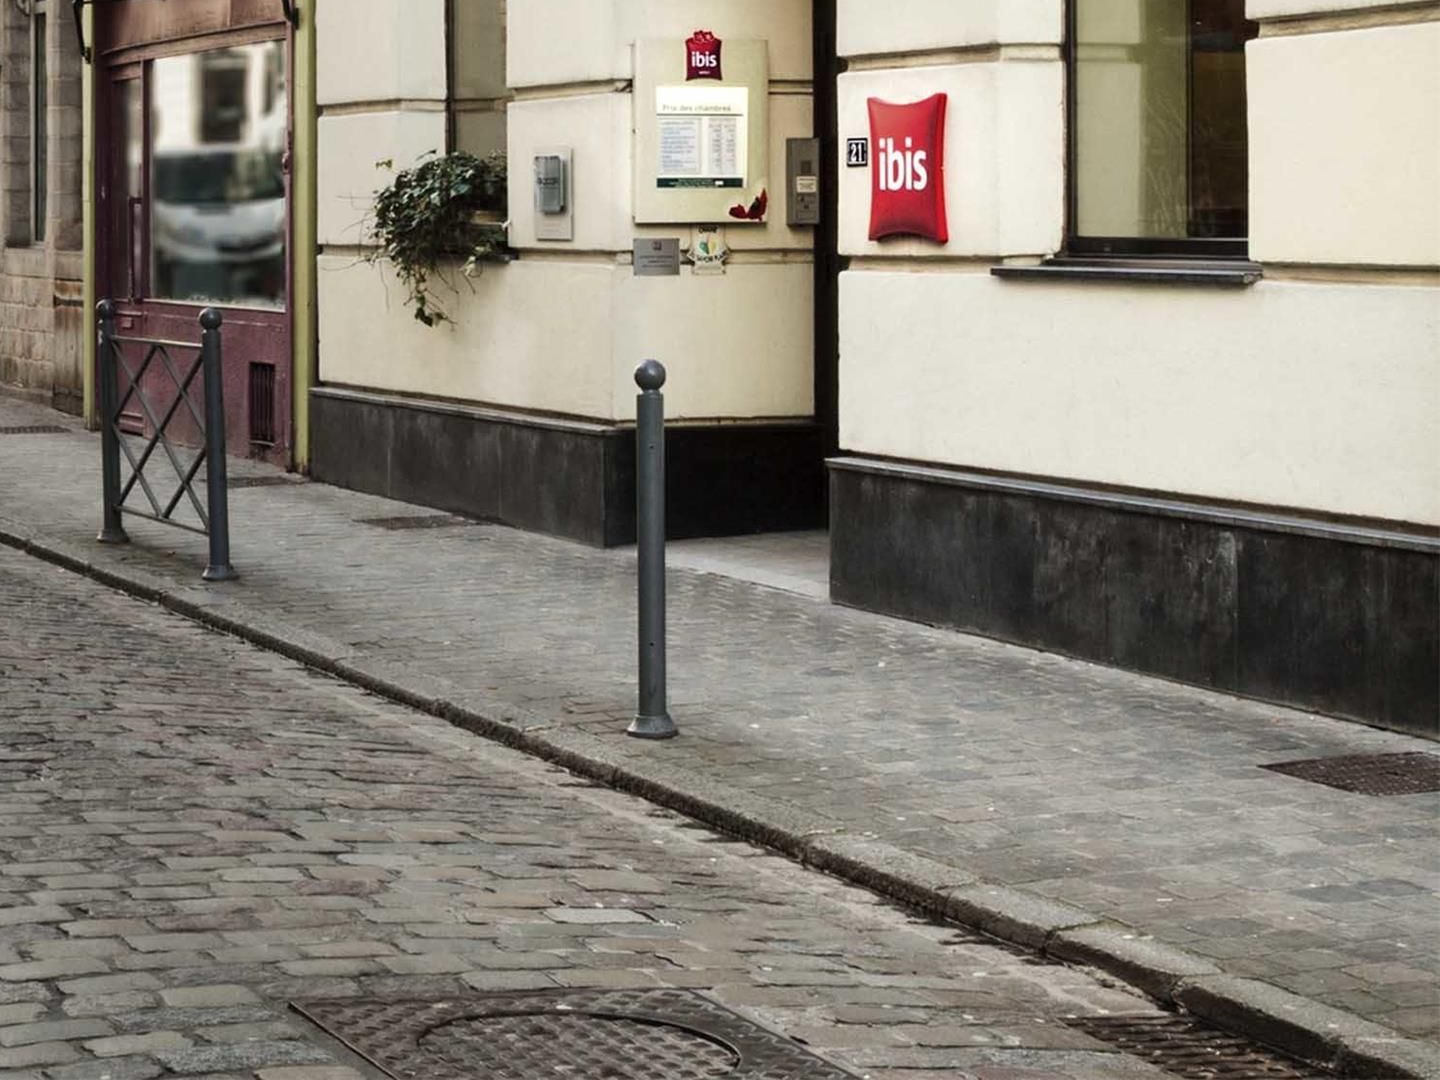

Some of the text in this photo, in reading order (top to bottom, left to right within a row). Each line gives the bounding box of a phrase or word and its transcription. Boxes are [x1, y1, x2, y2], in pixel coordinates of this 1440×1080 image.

[691, 51, 717, 67] ibis
[850, 143, 862, 162] 21
[879, 136, 928, 191] ibis
